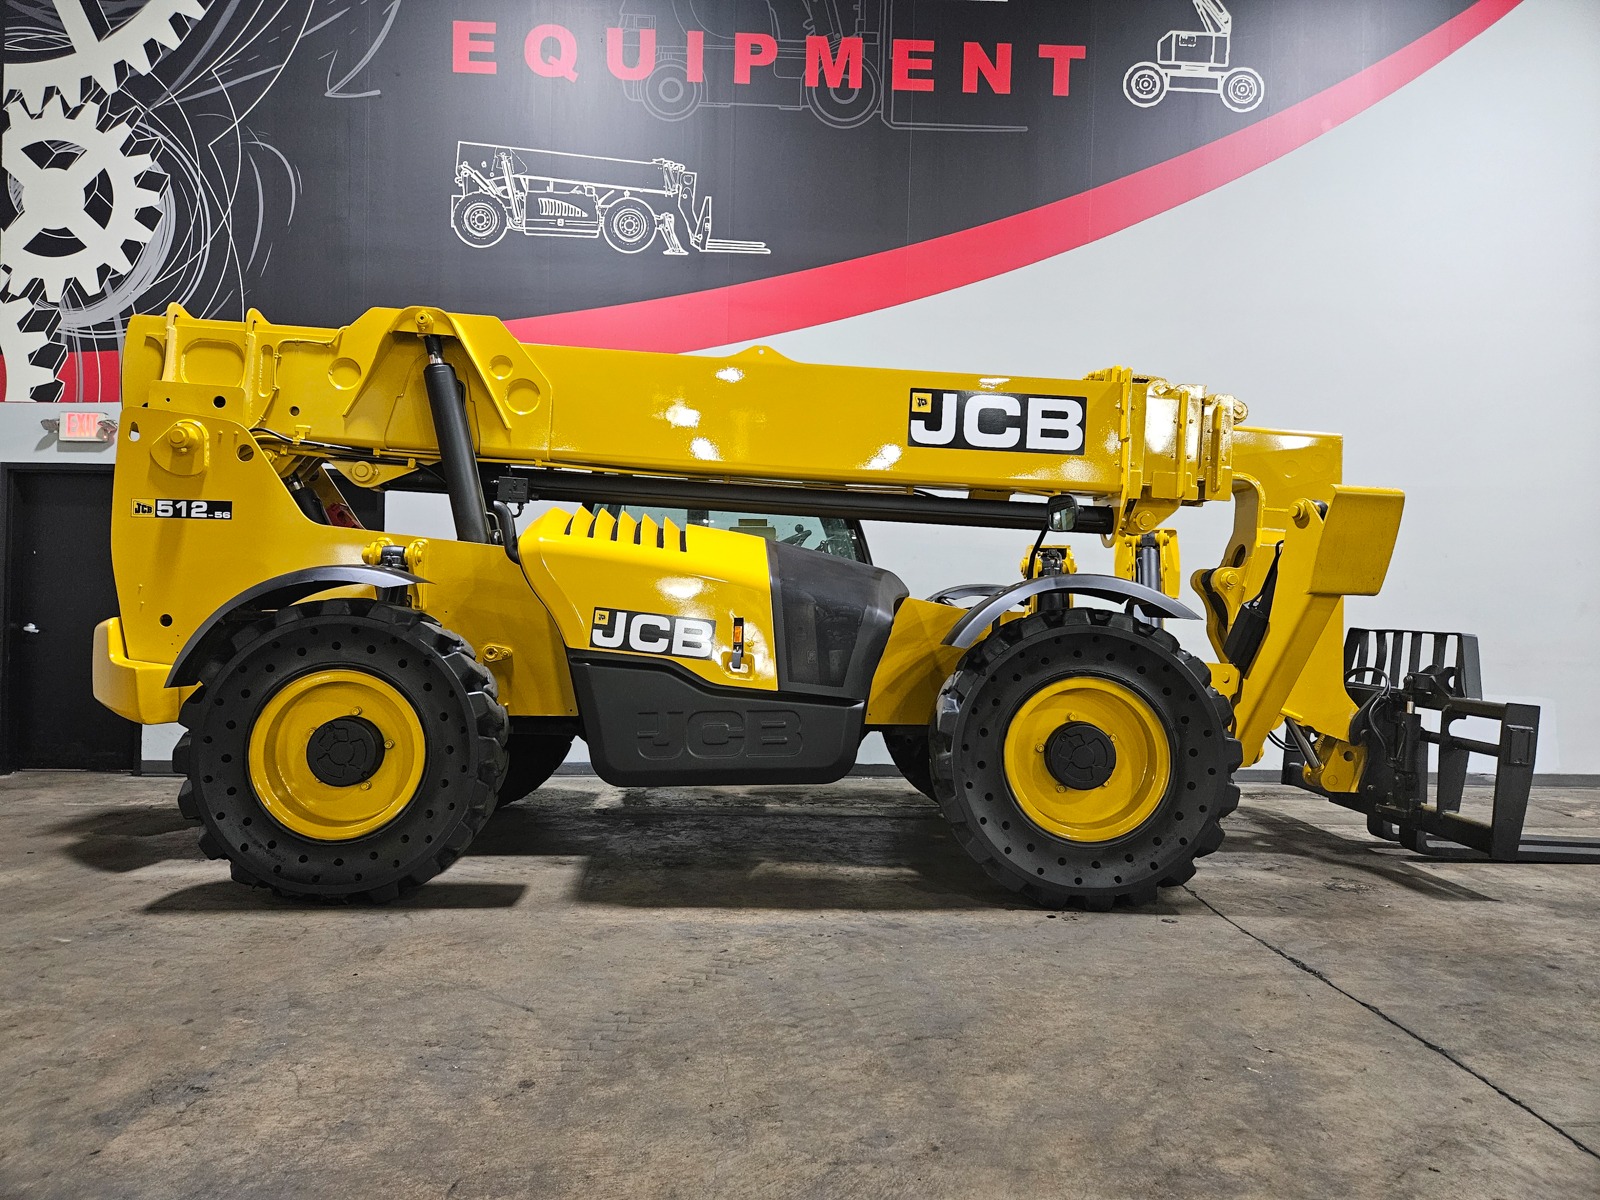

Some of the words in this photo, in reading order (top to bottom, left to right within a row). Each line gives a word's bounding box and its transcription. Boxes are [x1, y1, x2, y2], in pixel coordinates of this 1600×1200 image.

[452, 20, 1086, 97] EQUIPMENT
[67, 413, 99, 437] EXIT
[911, 393, 1084, 451] JCB
[134, 502, 153, 514] JCB
[592, 611, 713, 658] JCB
[637, 710, 803, 761] JCB
